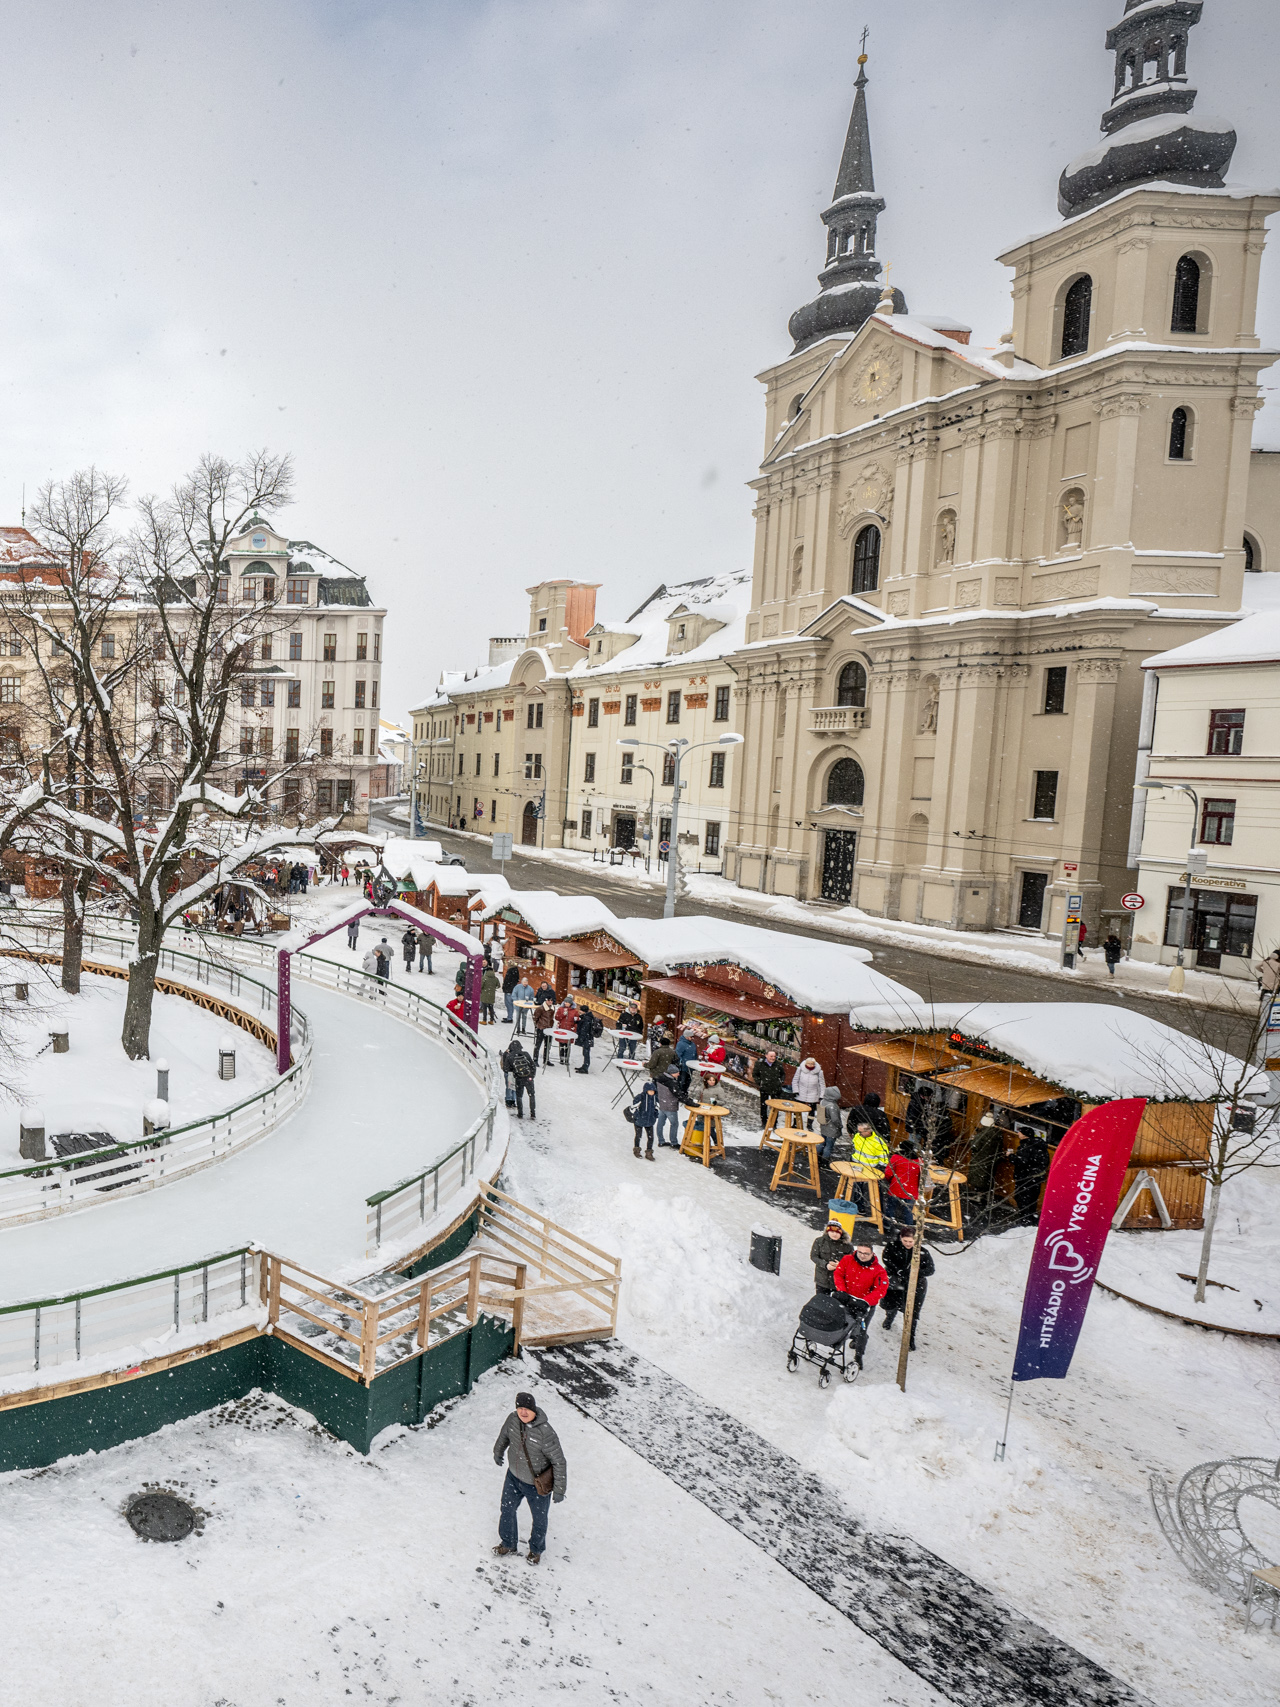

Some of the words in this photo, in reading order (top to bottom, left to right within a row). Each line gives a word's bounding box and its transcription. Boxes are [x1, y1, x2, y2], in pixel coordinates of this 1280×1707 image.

[1191, 876, 1247, 888] Kooperativa
[1039, 1280, 1066, 1348] HITRÁDIO
[1067, 1154, 1102, 1232] VYSOČINA
